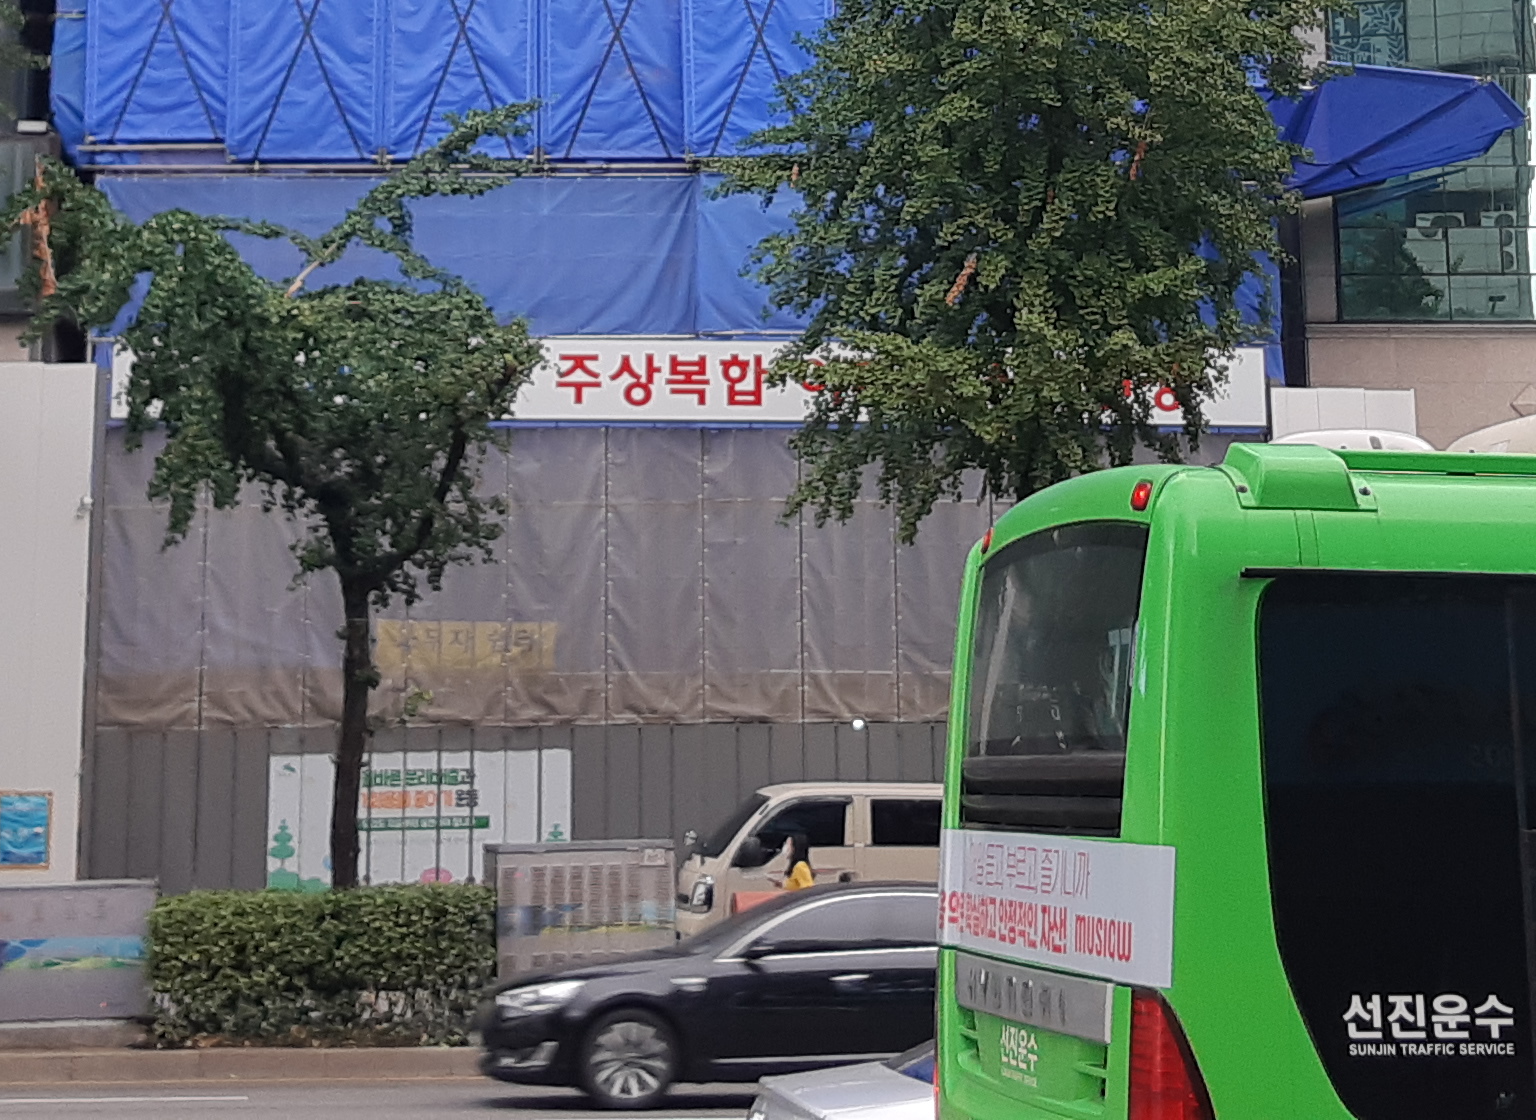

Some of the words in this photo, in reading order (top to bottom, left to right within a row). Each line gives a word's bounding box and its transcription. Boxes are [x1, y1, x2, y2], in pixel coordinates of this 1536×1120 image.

[555, 353, 766, 407] 주상복합
[1342, 993, 1514, 1040] 선진운수
[999, 1024, 1039, 1072] 선진운수
[1349, 1042, 1396, 1056] SUNJIN
[1400, 1042, 1455, 1056] TRAFFIC
[1459, 1042, 1515, 1056] SERVICE
